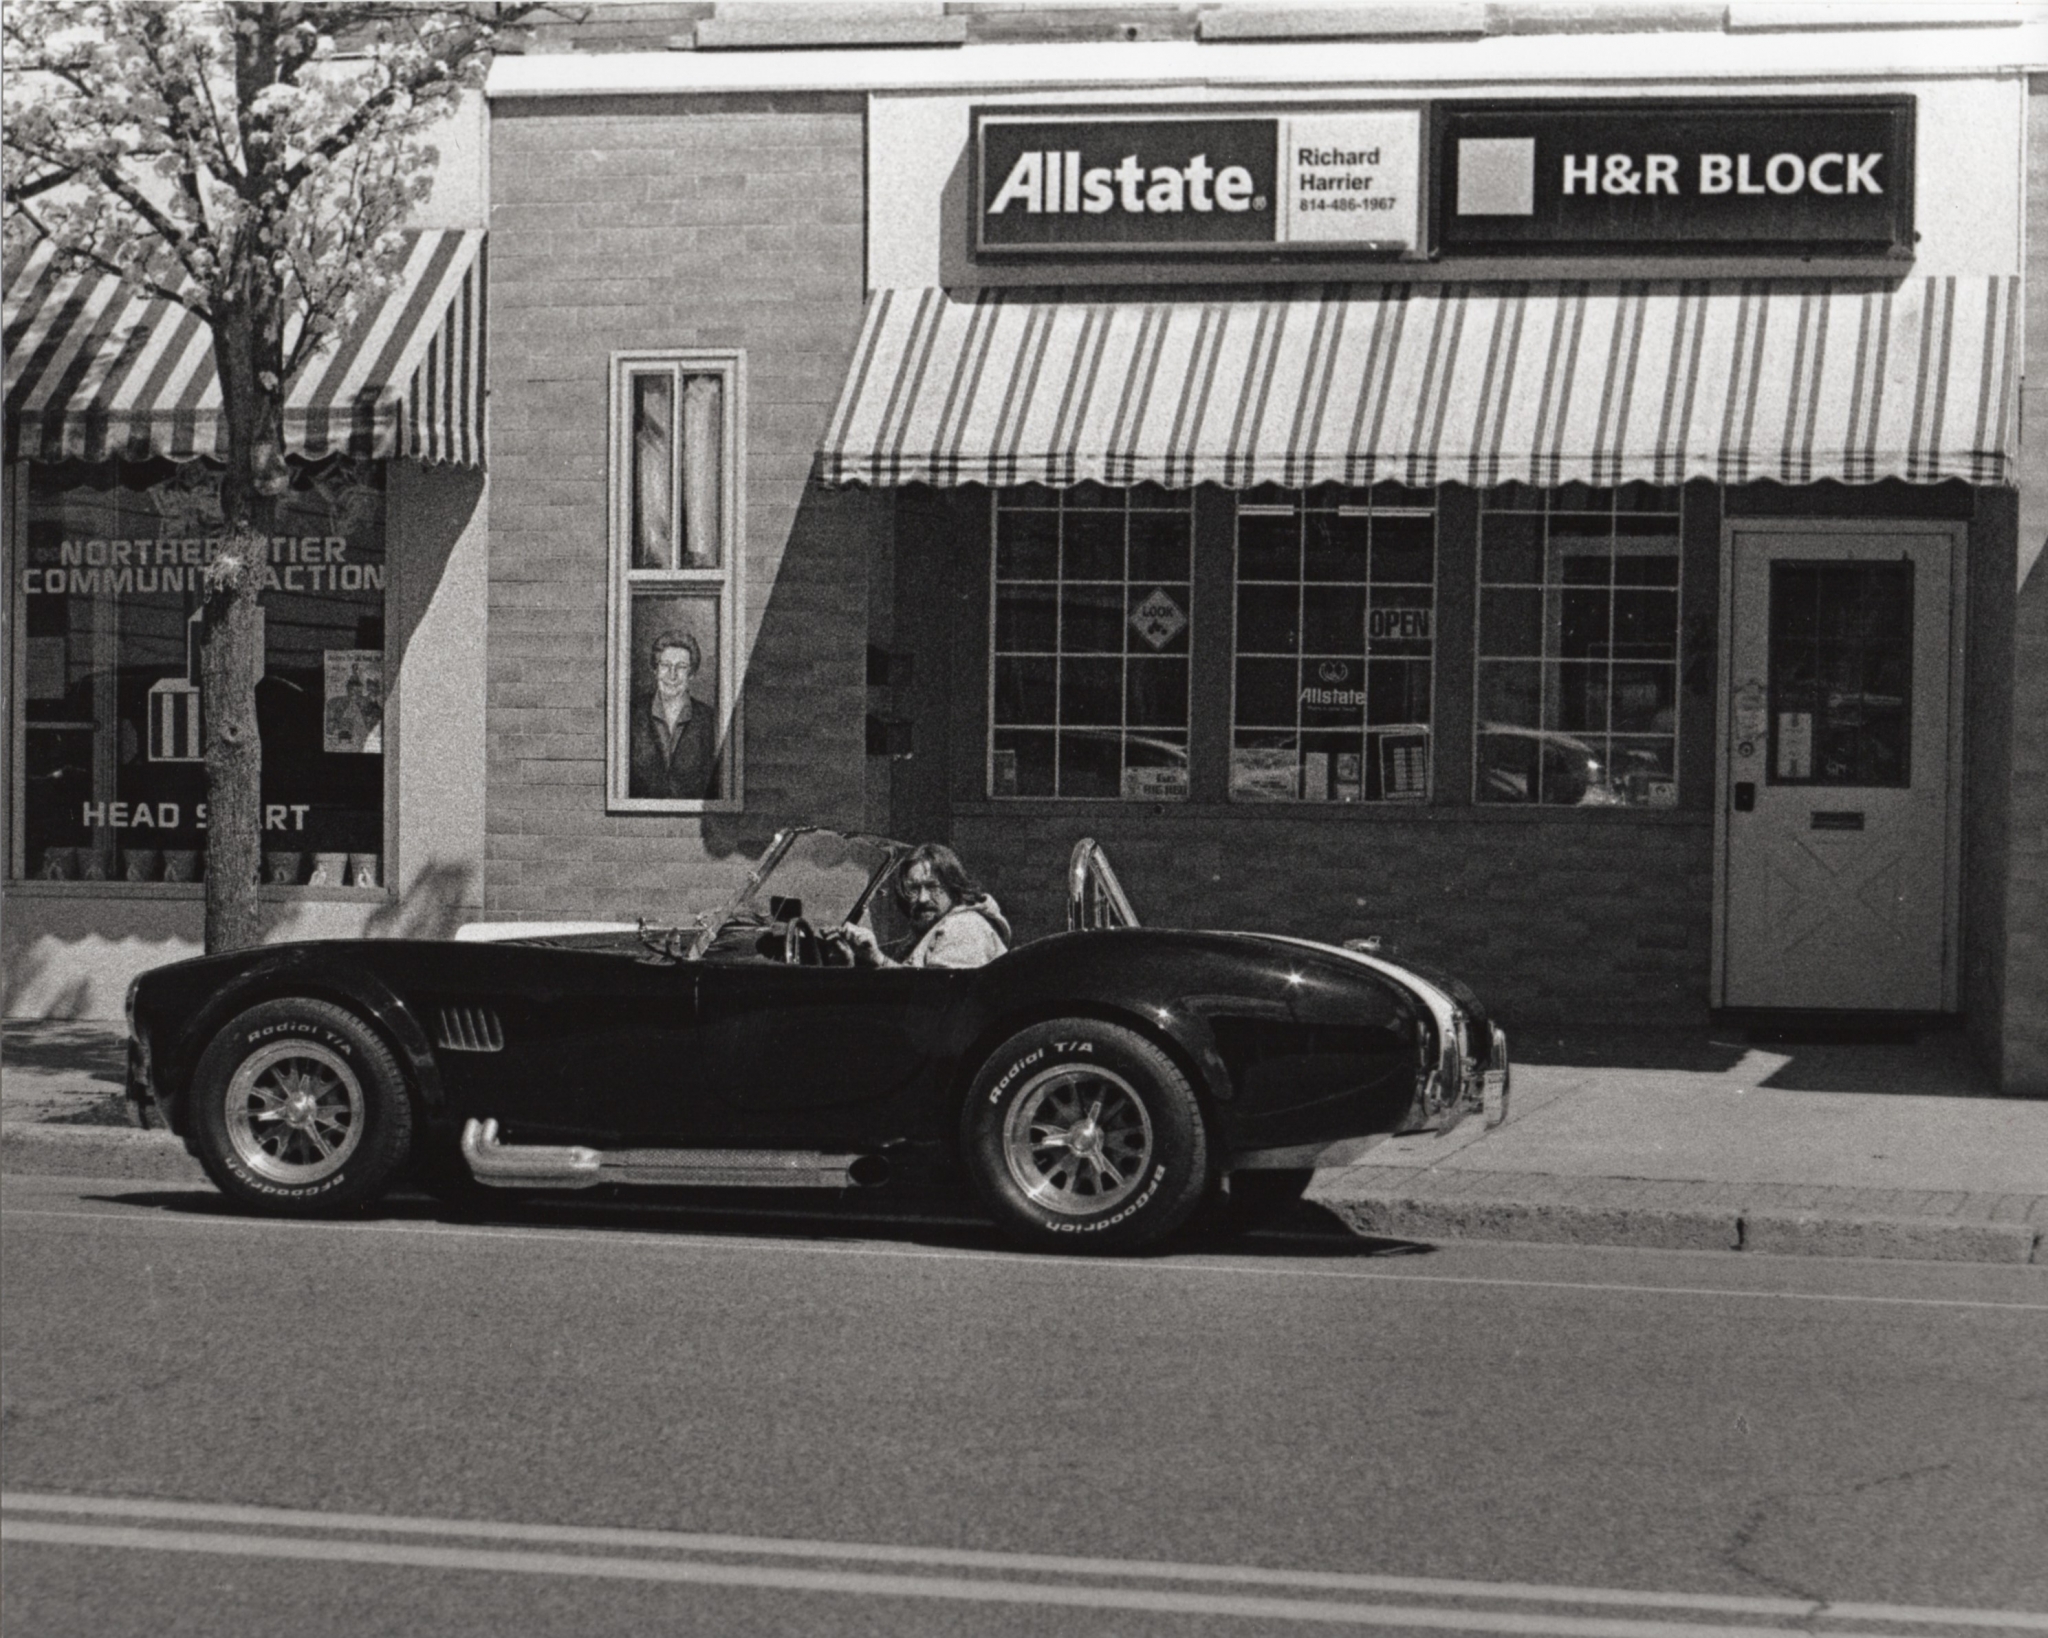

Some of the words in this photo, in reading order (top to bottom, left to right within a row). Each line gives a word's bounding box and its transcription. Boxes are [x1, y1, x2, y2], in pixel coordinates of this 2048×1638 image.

[1298, 148, 1381, 167] Richard
[987, 151, 1254, 214] Allstate
[1299, 173, 1373, 192] Harrier
[1562, 153, 1680, 195] H&R
[1699, 152, 1884, 195] BLOCK
[1299, 197, 1397, 212] 814-486-1967
[61, 538, 228, 566] NORTHER
[271, 536, 347, 563] TIER
[22, 564, 214, 594] COMMUNI
[252, 564, 386, 591] ACTION
[1142, 605, 1174, 618] LOOK
[1369, 609, 1430, 639] OPEN
[1299, 687, 1367, 705] Allstate
[83, 802, 180, 829] HEAD
[196, 803, 310, 831] SRT
[247, 1021, 318, 1043] Radial
[325, 1030, 352, 1055] T/A
[989, 1047, 1044, 1105] Radial
[1054, 1041, 1094, 1053] T/A
[1045, 1164, 1167, 1234] BFGoodrich
